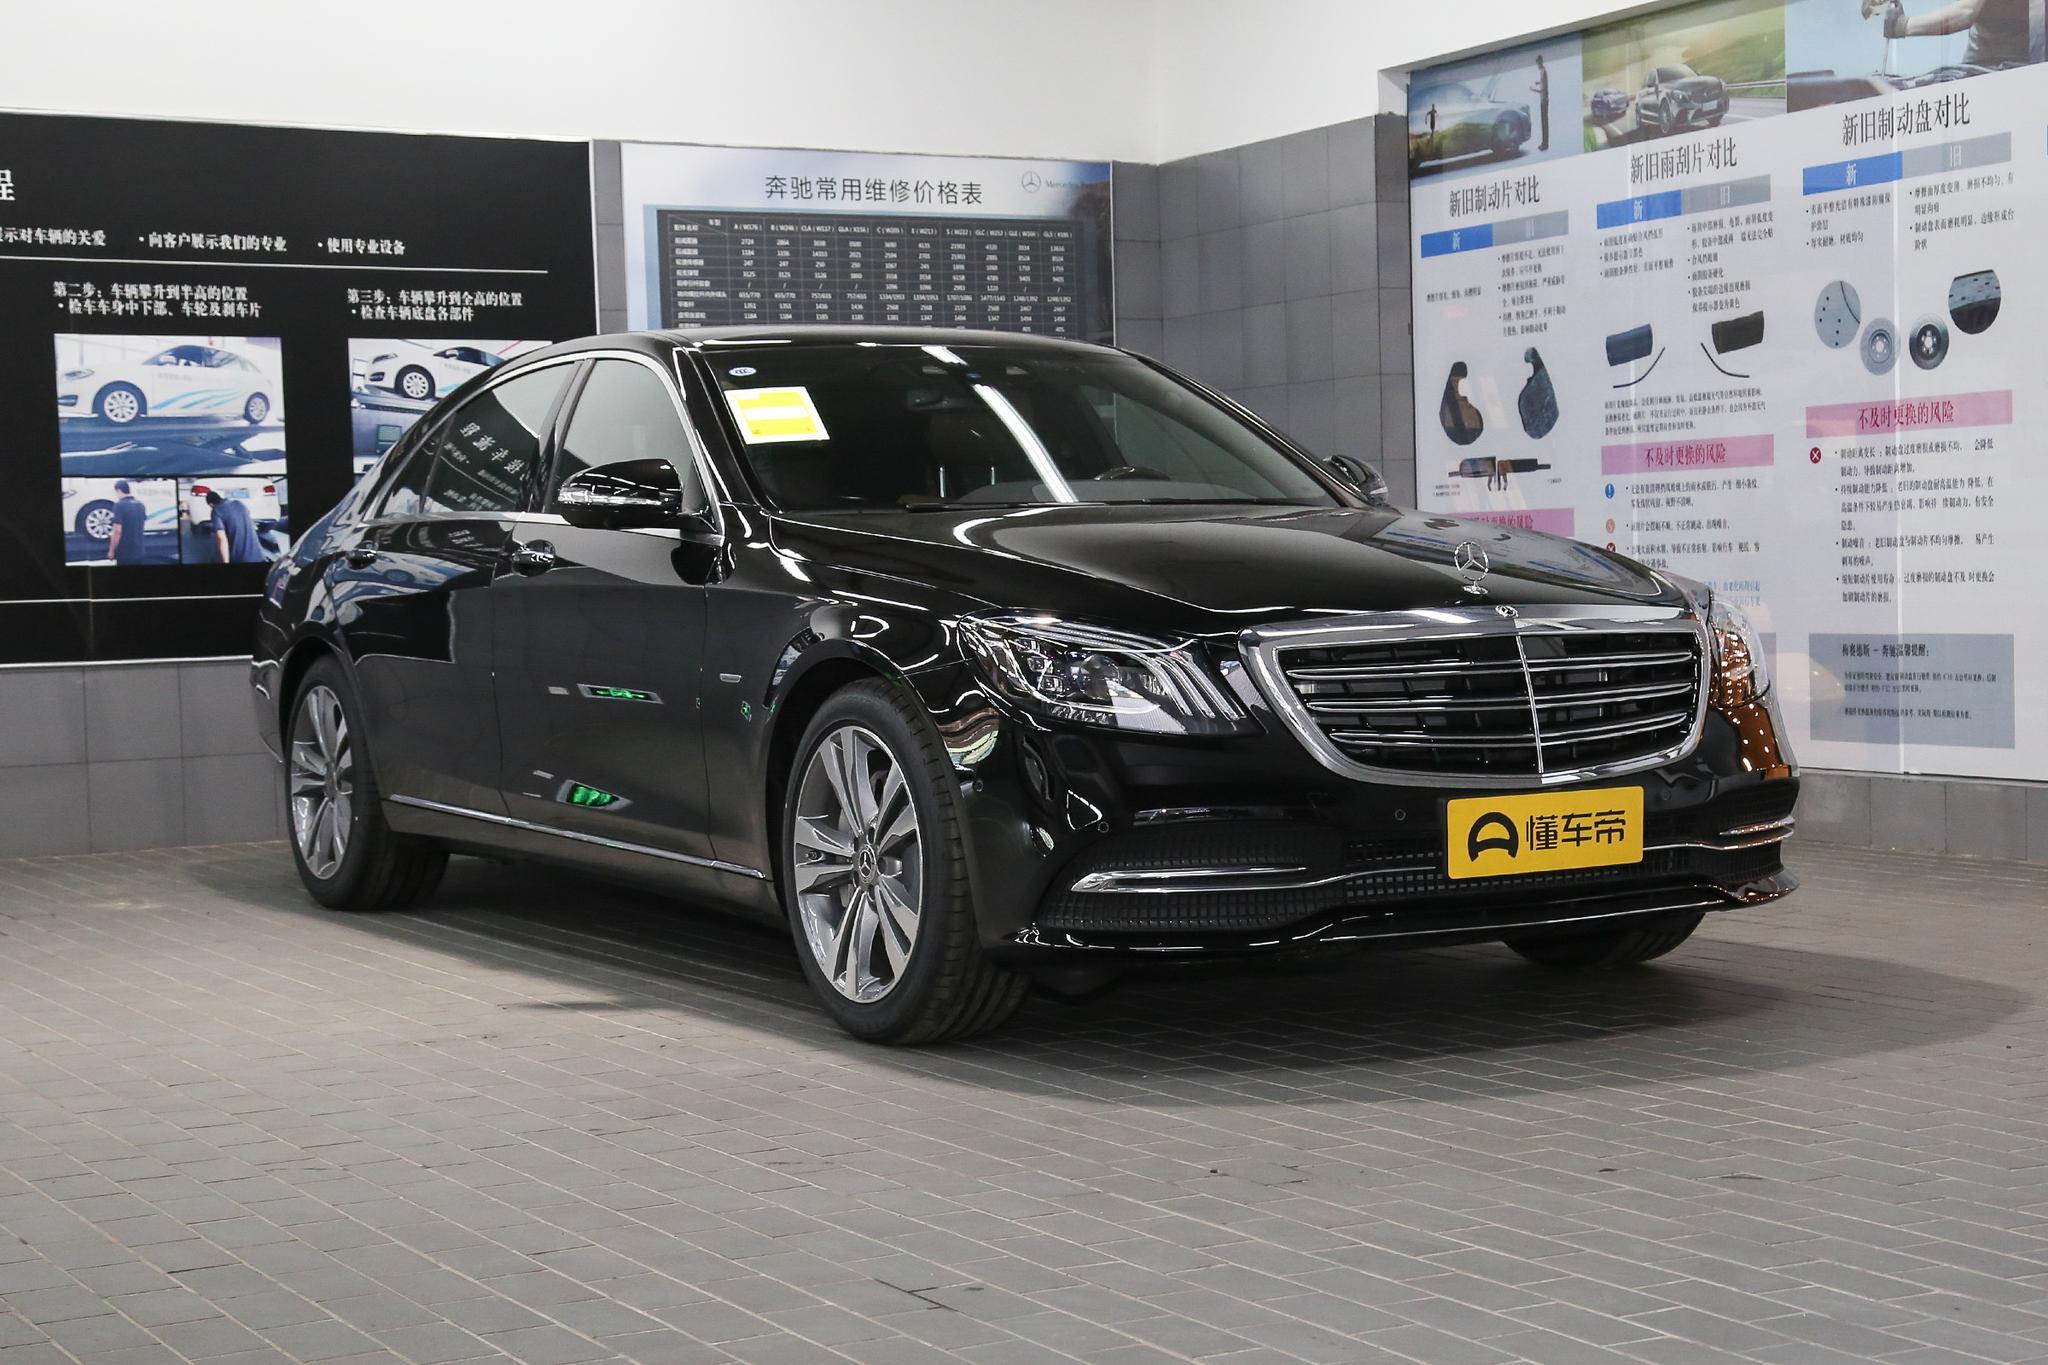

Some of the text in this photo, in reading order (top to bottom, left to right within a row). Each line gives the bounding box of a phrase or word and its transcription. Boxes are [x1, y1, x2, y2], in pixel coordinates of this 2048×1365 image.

[1842, 92, 1970, 147] 新旧制动盘对比
[1631, 137, 1737, 185] 新旧雨刮片对比
[1846, 164, 1858, 185] 新
[765, 175, 983, 205] 奔驰常用维修价格表
[1450, 175, 1540, 218] 新旧制动片对比
[0, 226, 406, 255] 示对车辆的关爱 向客户展示我们的专业 使用专业设备
[361, 305, 475, 321] 检查车辆底盘各部件
[1858, 401, 1955, 429] 不及时更换的风险
[1644, 443, 1728, 468] 不及时更换的风险
[1526, 809, 1626, 851] 懂车帝
